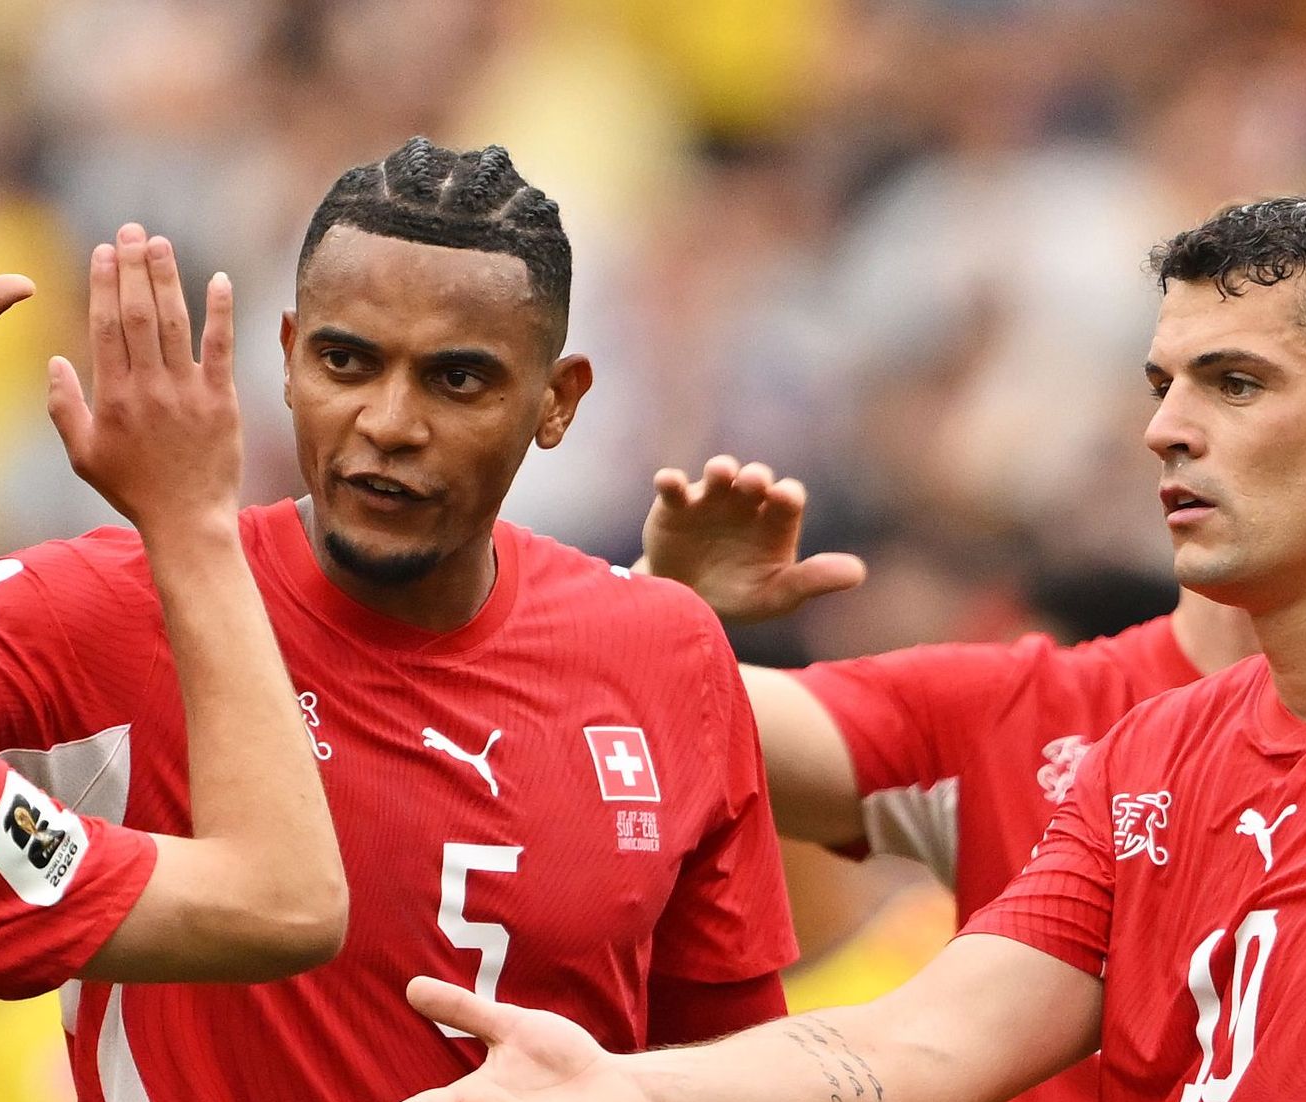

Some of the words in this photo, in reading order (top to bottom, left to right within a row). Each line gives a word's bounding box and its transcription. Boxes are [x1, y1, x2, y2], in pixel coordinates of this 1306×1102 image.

[616, 822, 634, 837] SUI
[642, 822, 660, 838] COL
[44, 852, 64, 880] WORLD
[61, 835, 72, 853] CUP
[49, 842, 79, 888] 2026
[436, 842, 525, 1039] 5
